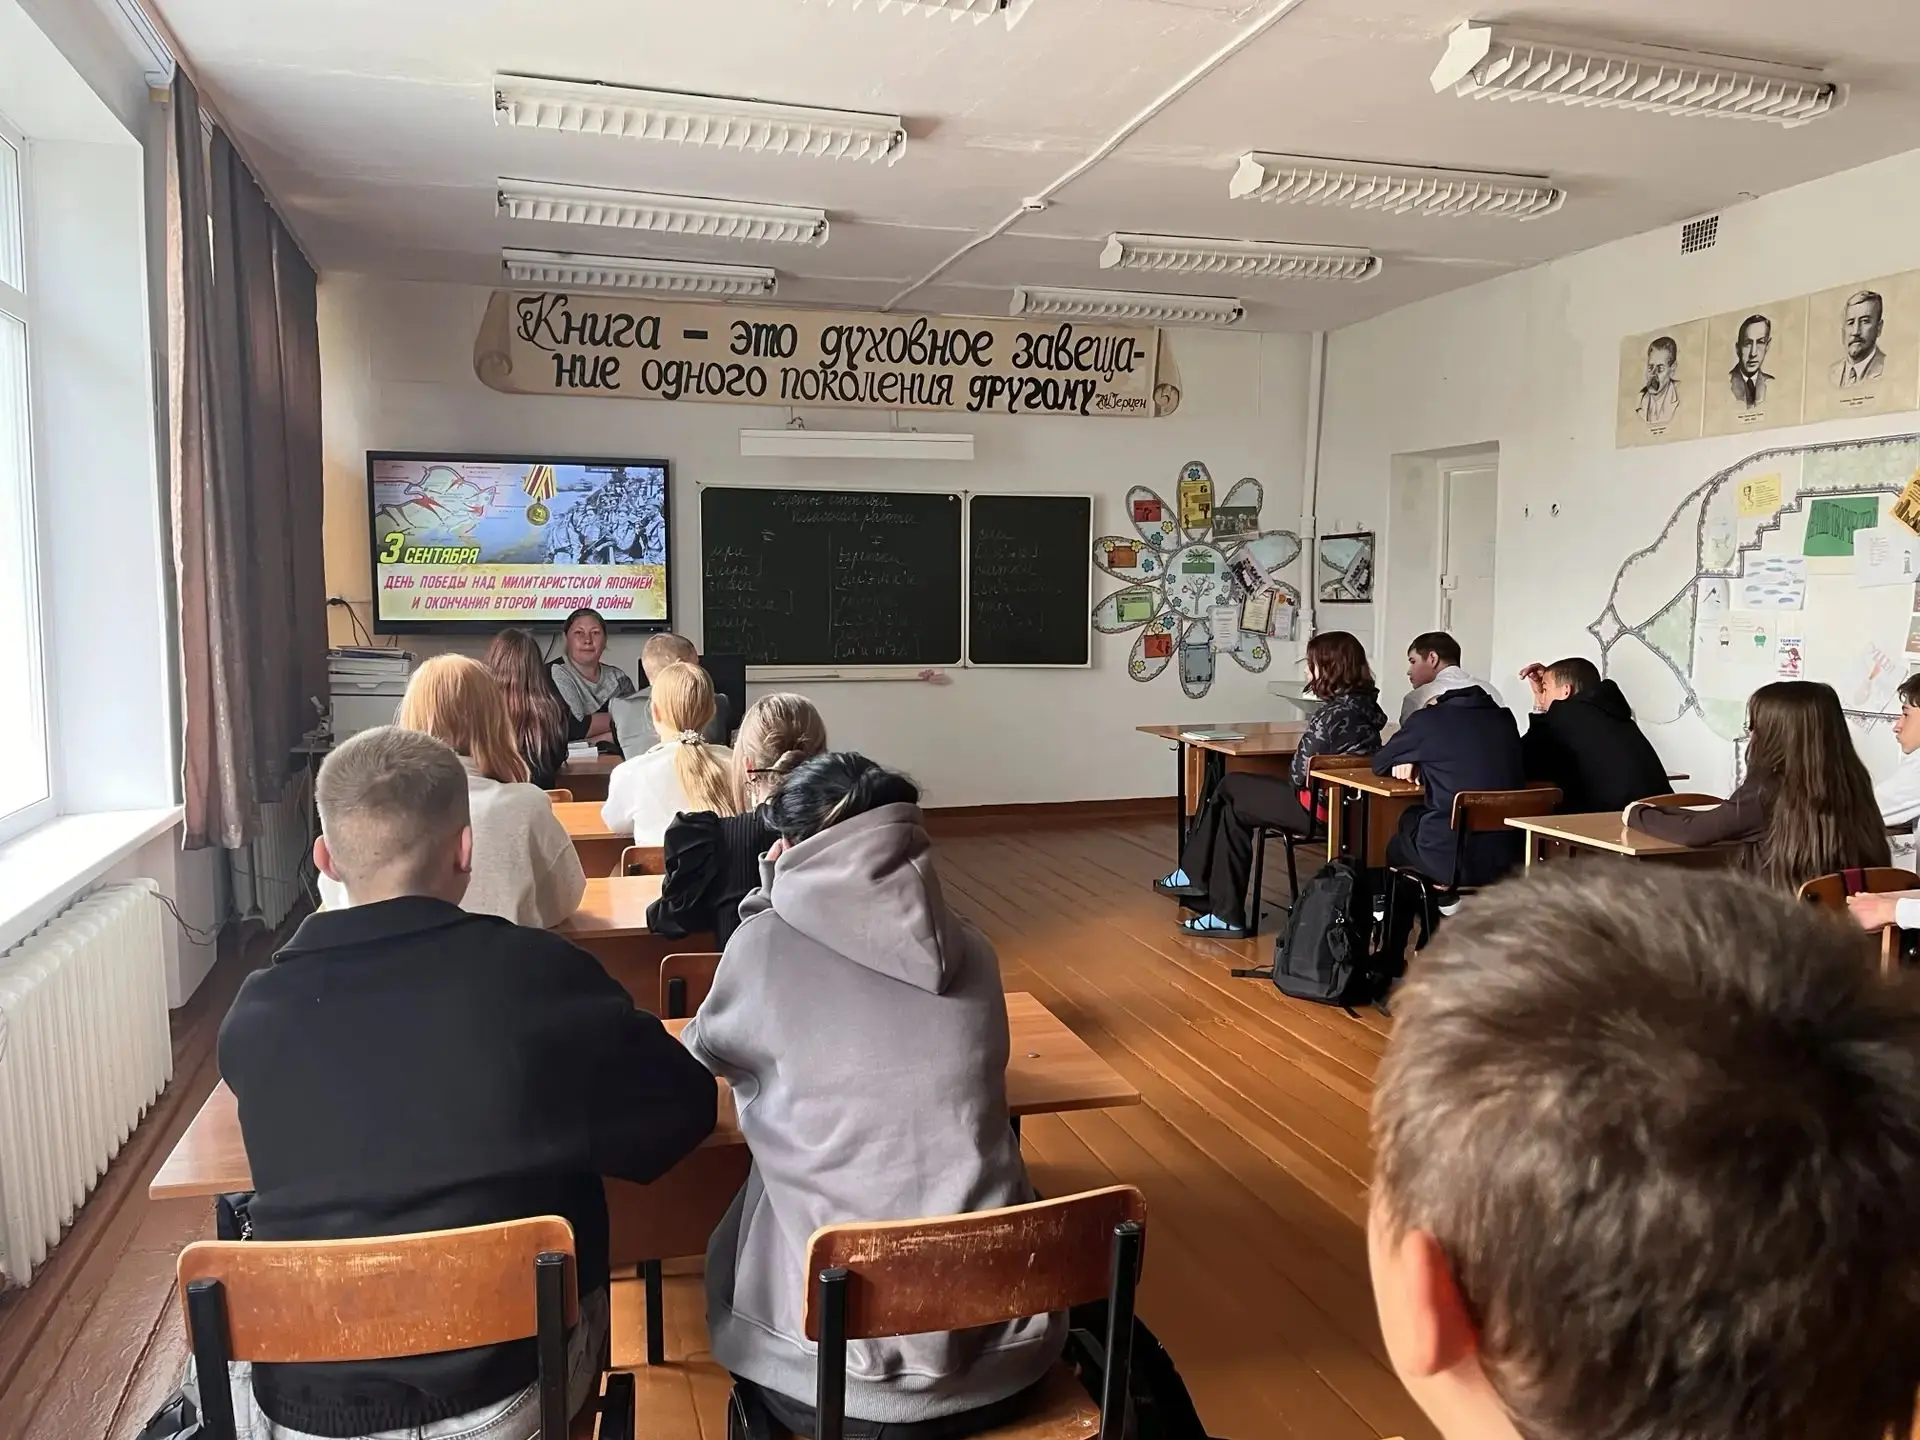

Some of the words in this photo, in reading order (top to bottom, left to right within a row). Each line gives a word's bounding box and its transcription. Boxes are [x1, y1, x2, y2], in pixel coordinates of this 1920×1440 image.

[516, 291, 662, 351] Книга
[729, 320, 798, 358] это
[819, 317, 994, 373] духовное
[1011, 323, 1145, 385] завеща-
[552, 352, 621, 390] ние
[641, 358, 768, 401] одного
[780, 366, 955, 406] поколения
[966, 374, 1097, 417] другому
[379, 531, 405, 565] 3
[403, 546, 481, 565] СЕНТЯБРЯ
[384, 575, 415, 590] ДЕНЬ
[419, 575, 468, 590] ПОБЕДЫ
[471, 576, 496, 590] НАД
[500, 574, 602, 589] МИЛИТАРИСТСКОЙ
[605, 574, 654, 590] ЯПОНИЕЙ
[411, 596, 421, 610] И
[424, 596, 491, 610] ОКОНЧАНИЯ
[493, 594, 538, 610] ВТОРОЙ
[540, 594, 593, 610] МИРОВОЙ
[596, 594, 635, 610] ВОЙНЫ
